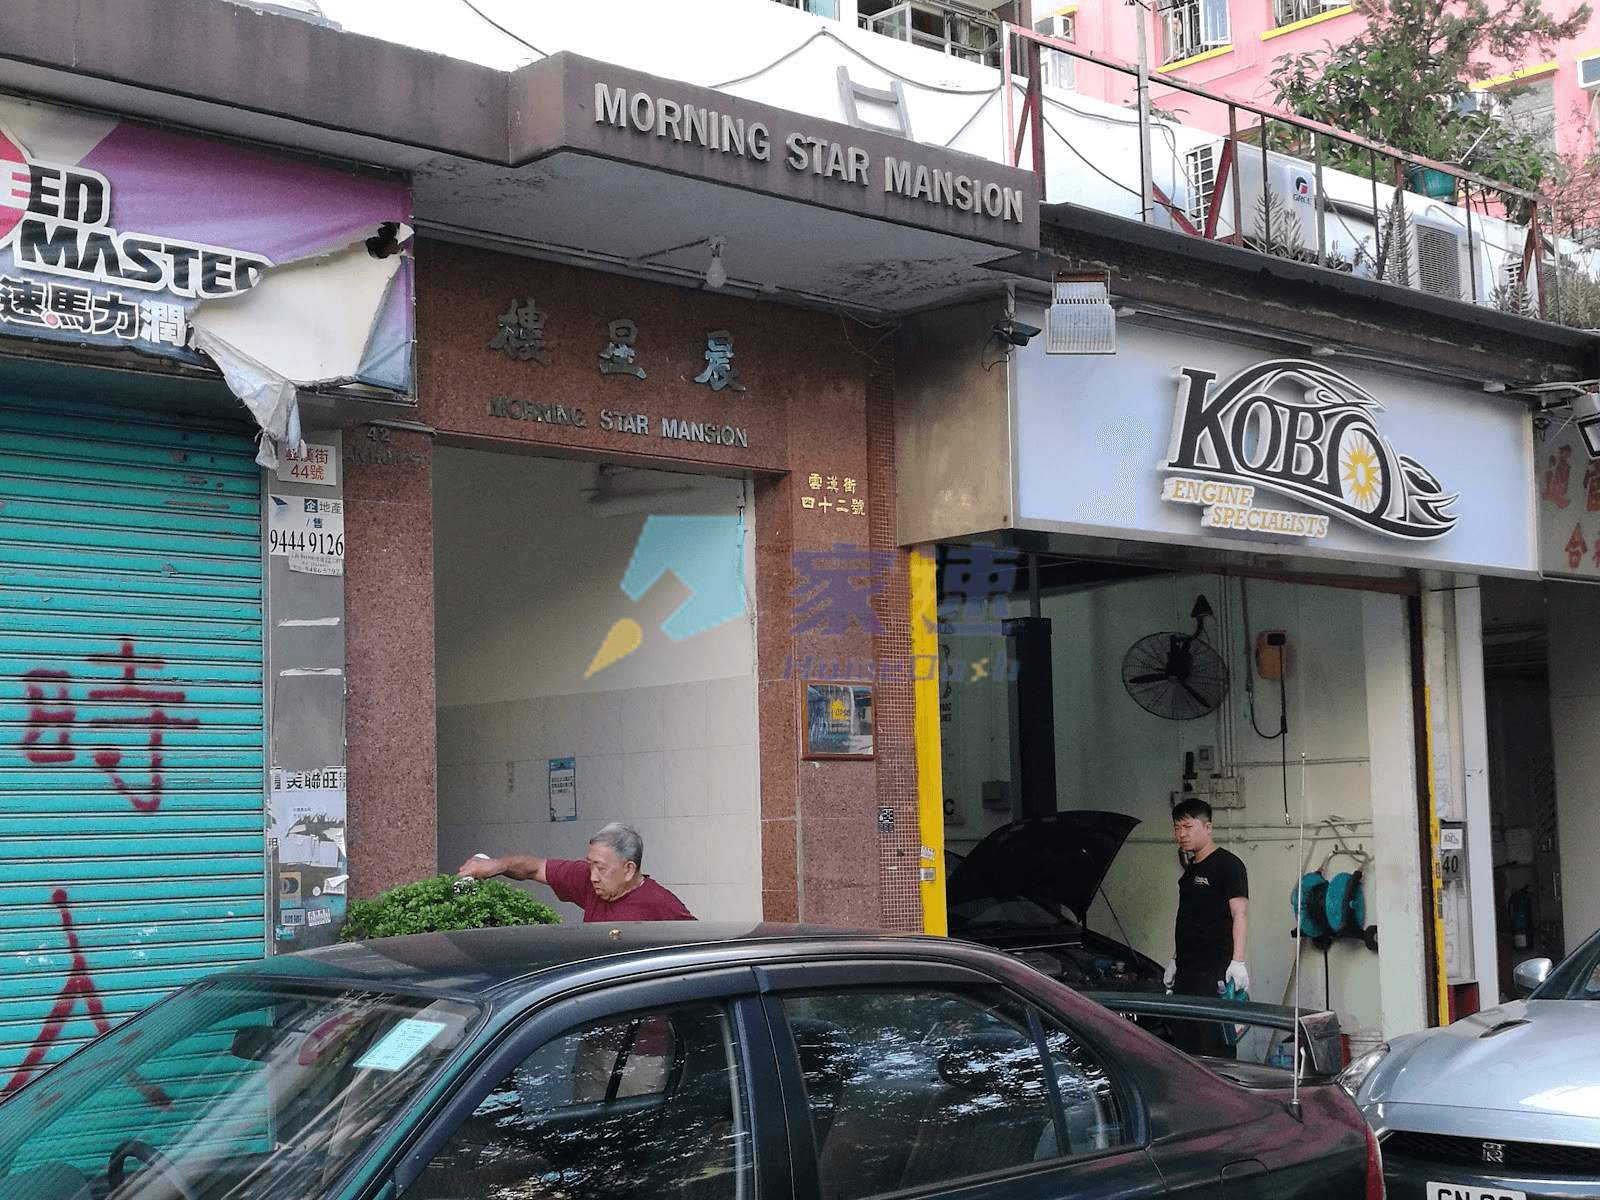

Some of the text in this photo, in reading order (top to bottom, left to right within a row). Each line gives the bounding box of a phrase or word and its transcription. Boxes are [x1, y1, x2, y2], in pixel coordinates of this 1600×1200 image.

[594, 82, 1024, 224] MORNING STAR MANSION
[367, 425, 390, 442] 42
[486, 396, 748, 449] MORNING STAR MANSION
[1167, 364, 1392, 518] KOBO
[290, 464, 324, 481] 44號
[808, 473, 857, 495] 雲漢街
[801, 496, 866, 516] 四十二號
[1172, 480, 1254, 506] ENGINE
[1211, 509, 1330, 536] SPECIALISTS
[270, 529, 344, 556] 9444 9126
[1442, 855, 1459, 874] 40
